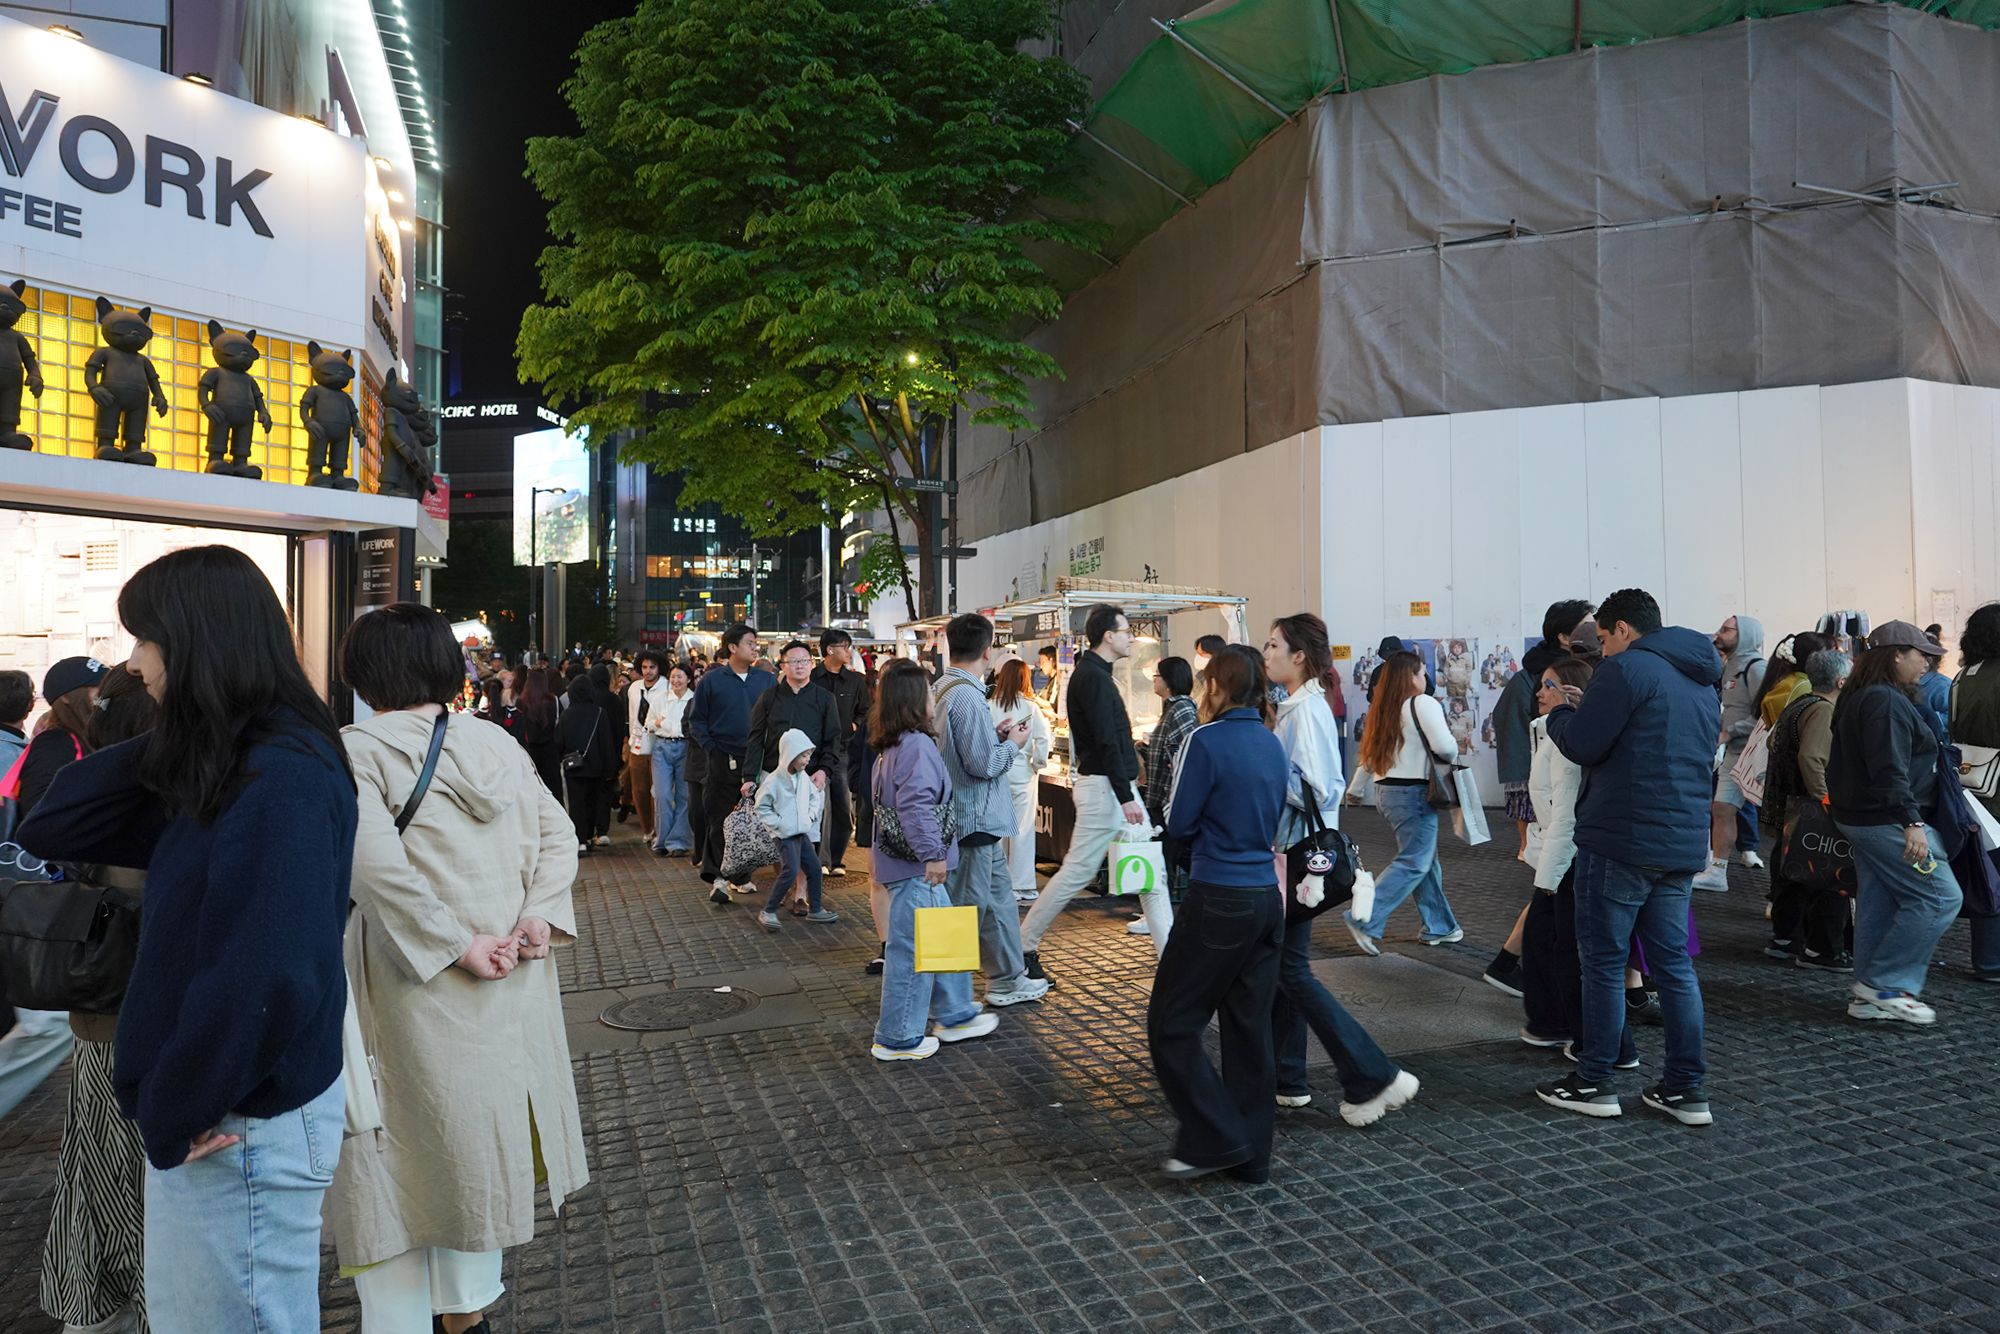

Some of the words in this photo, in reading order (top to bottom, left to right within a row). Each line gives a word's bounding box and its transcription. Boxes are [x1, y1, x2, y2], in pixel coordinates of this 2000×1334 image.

[480, 403, 519, 417] HOTEL
[361, 538, 395, 551] LIFEWORK
[362, 569, 371, 579] B1
[362, 581, 371, 591] B2
